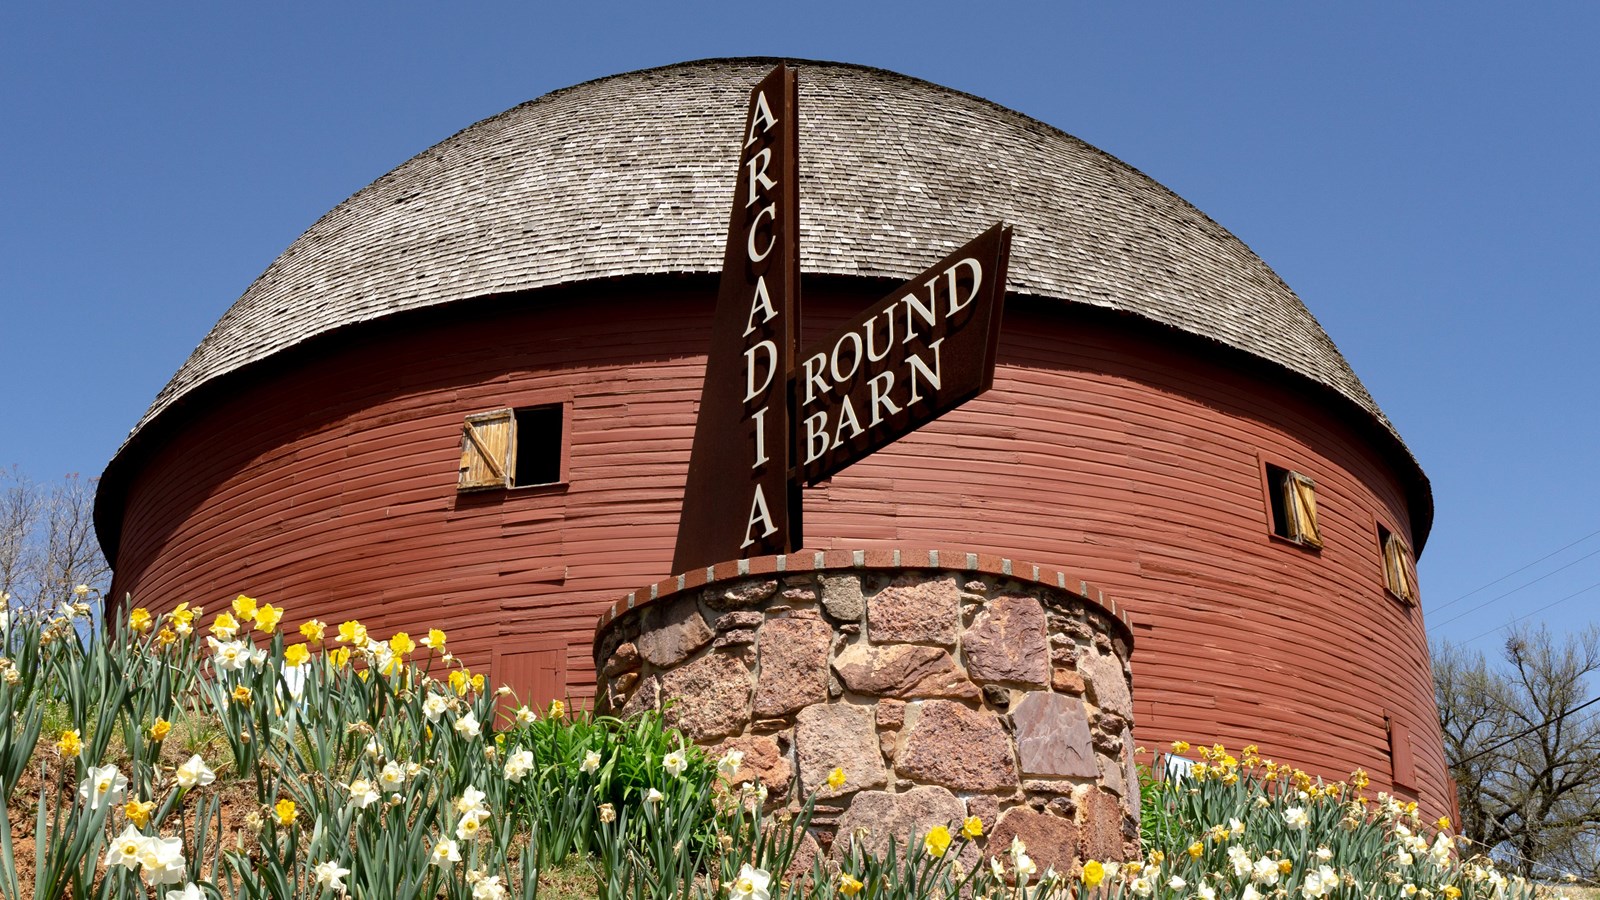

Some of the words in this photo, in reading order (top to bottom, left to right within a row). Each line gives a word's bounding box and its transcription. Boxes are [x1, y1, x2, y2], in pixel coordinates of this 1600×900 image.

[740, 90, 779, 550] ARCADIA
[802, 257, 983, 407] ROUND
[803, 337, 945, 467] BARN
